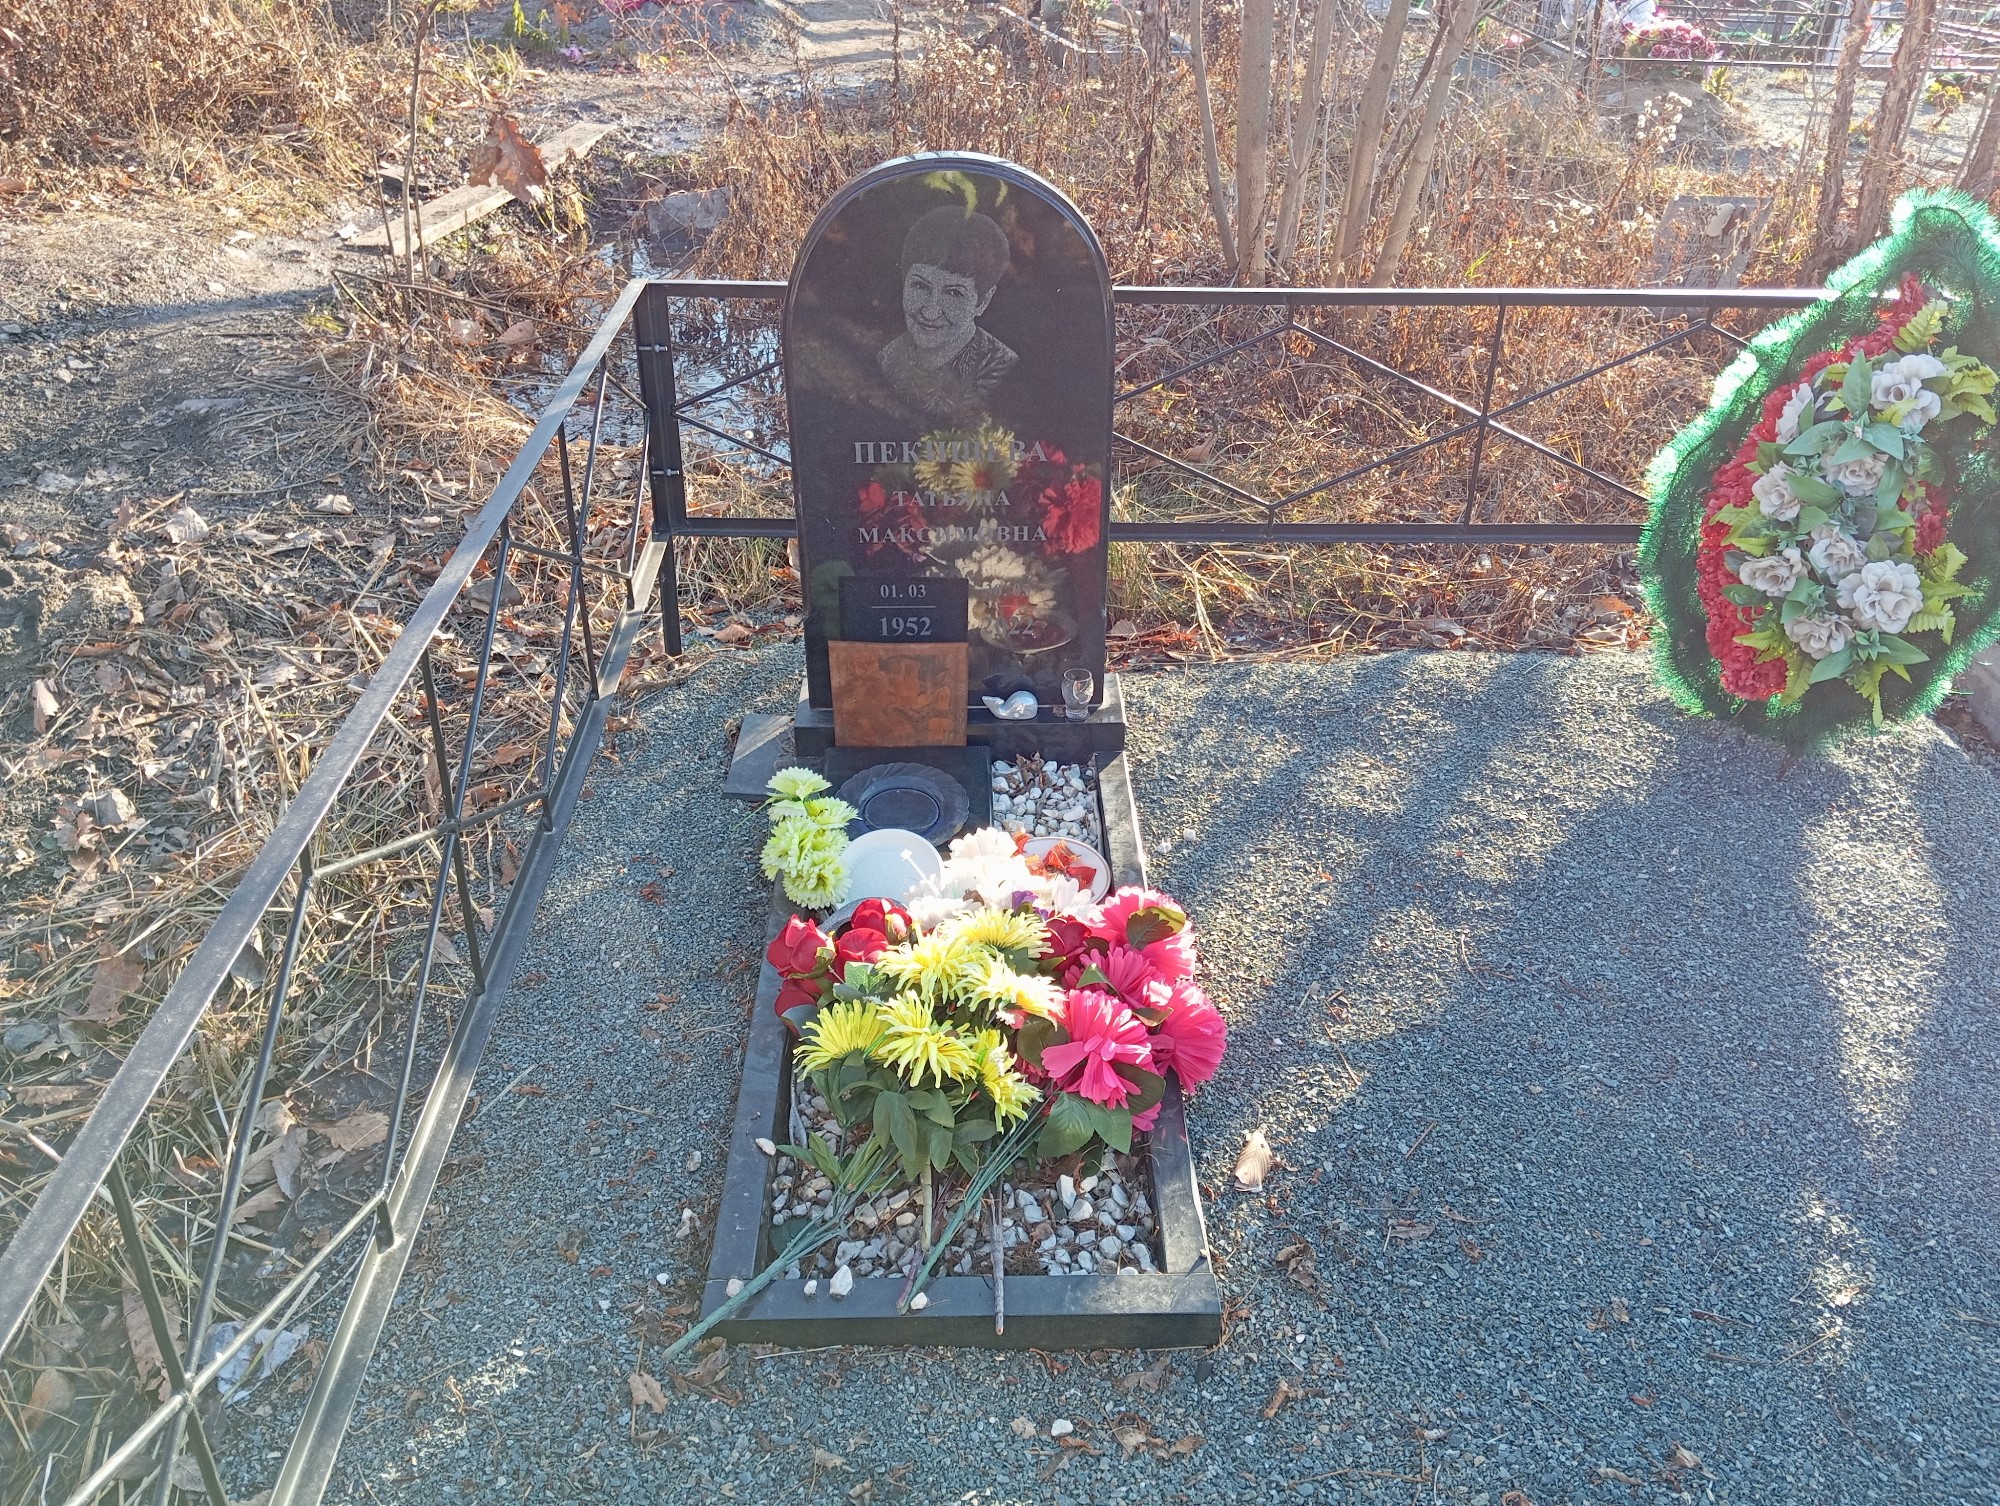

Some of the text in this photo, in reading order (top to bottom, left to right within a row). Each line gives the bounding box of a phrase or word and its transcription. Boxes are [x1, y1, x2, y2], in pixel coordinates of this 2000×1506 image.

[893, 489, 1011, 508] ТАТЬЯНА
[857, 525, 1048, 544] МАКСИМОВНА
[879, 616, 932, 636] 1952
